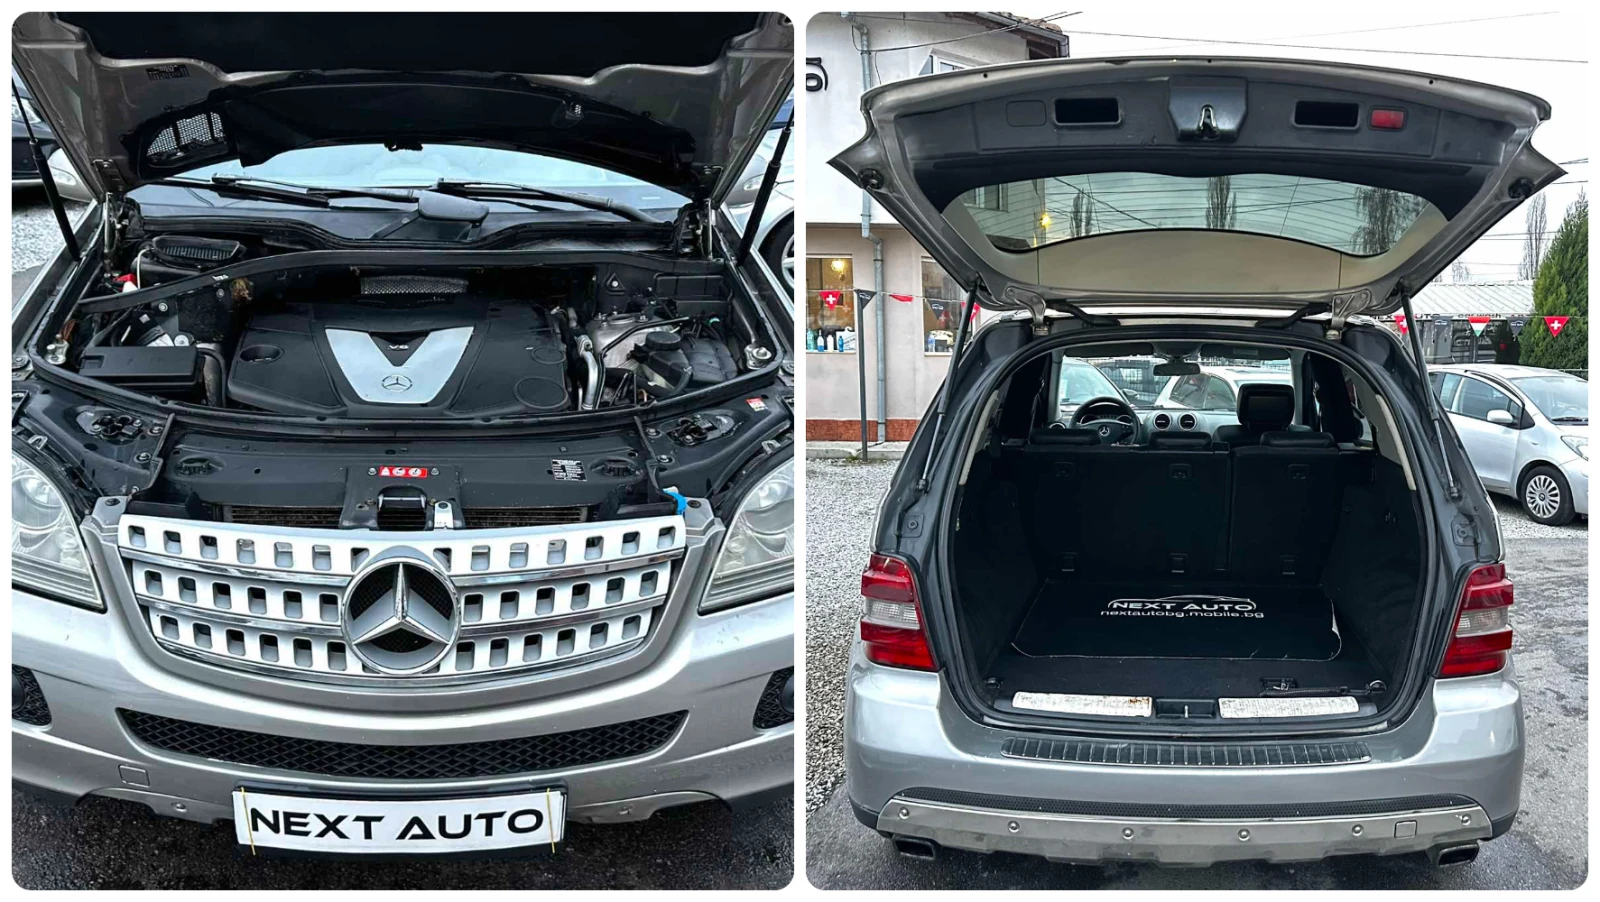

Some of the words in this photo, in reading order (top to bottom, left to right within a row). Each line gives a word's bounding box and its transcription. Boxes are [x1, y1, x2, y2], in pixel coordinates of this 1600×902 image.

[1112, 602, 1177, 610] NEXT
[1182, 603, 1253, 611] AUTO
[1100, 610, 1264, 619] nextautobg.mobile.bg
[250, 807, 385, 841] NEXT
[396, 808, 544, 841] AUTO
